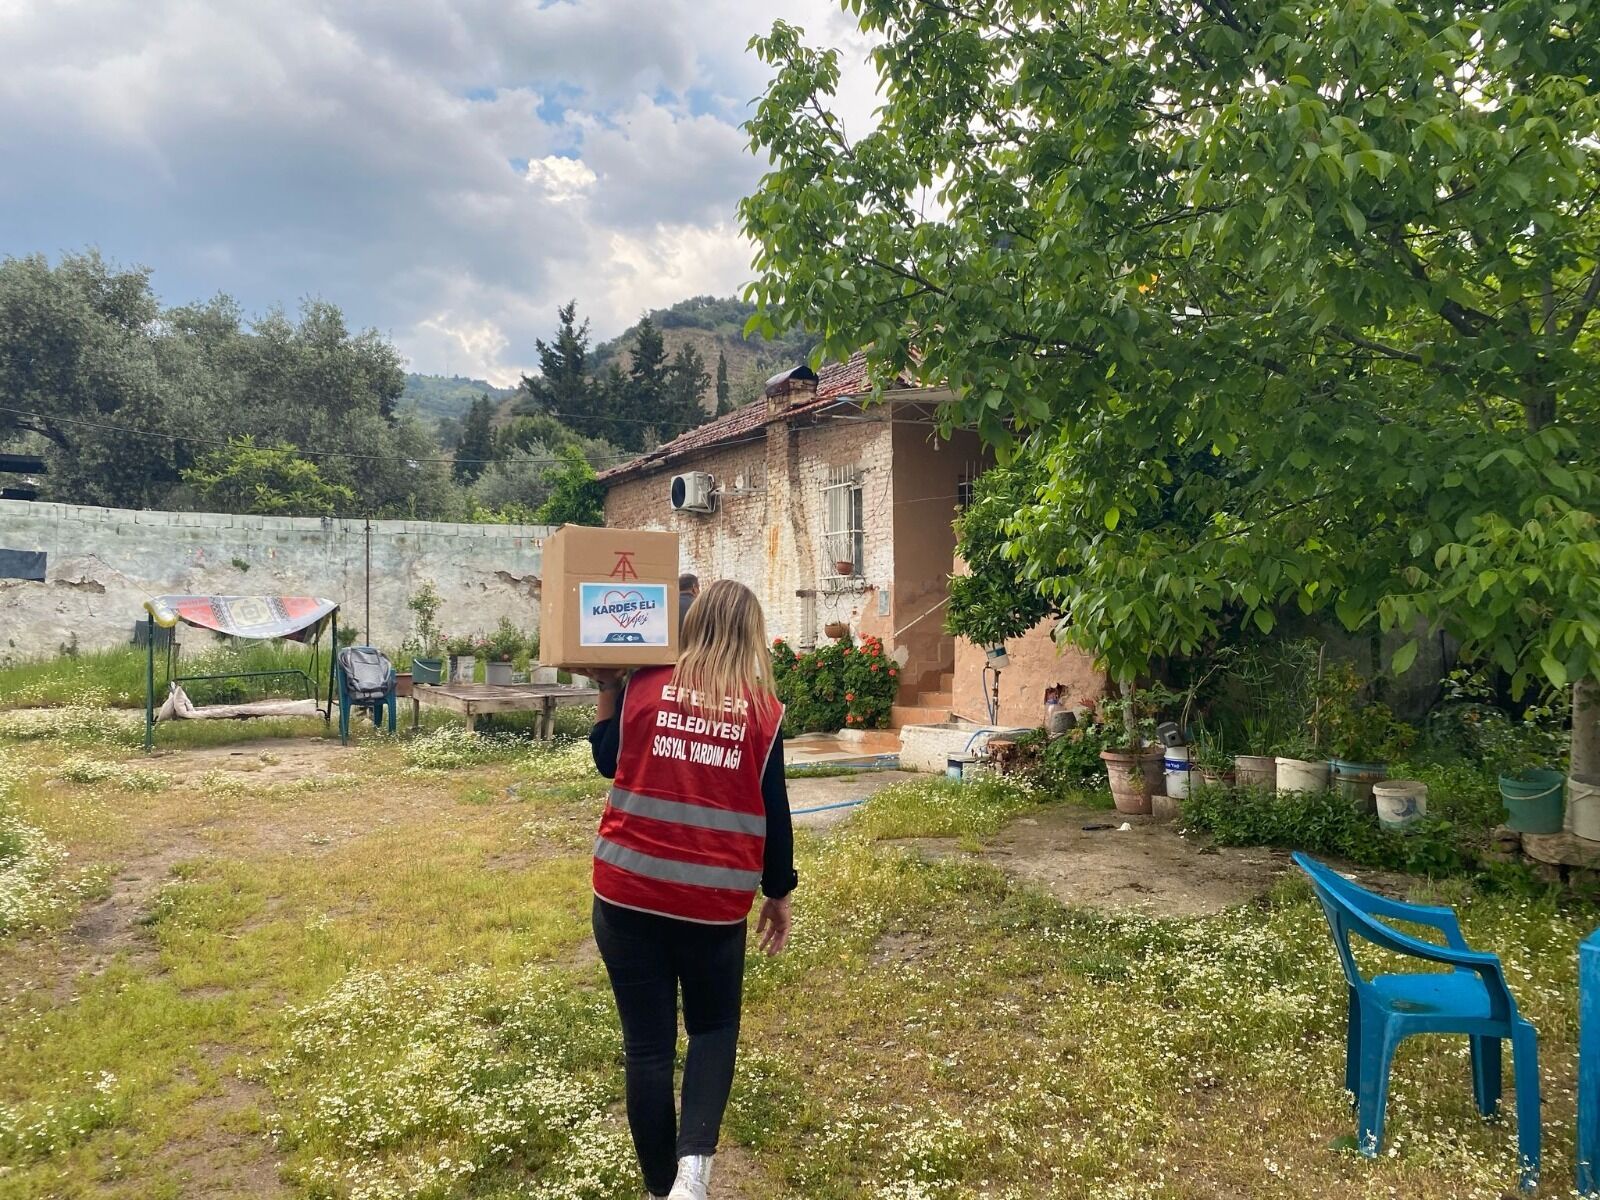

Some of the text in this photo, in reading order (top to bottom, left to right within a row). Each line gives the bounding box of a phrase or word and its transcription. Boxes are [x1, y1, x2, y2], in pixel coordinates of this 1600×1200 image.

[652, 734, 742, 770] SOSYAL YARDIM AĞI
